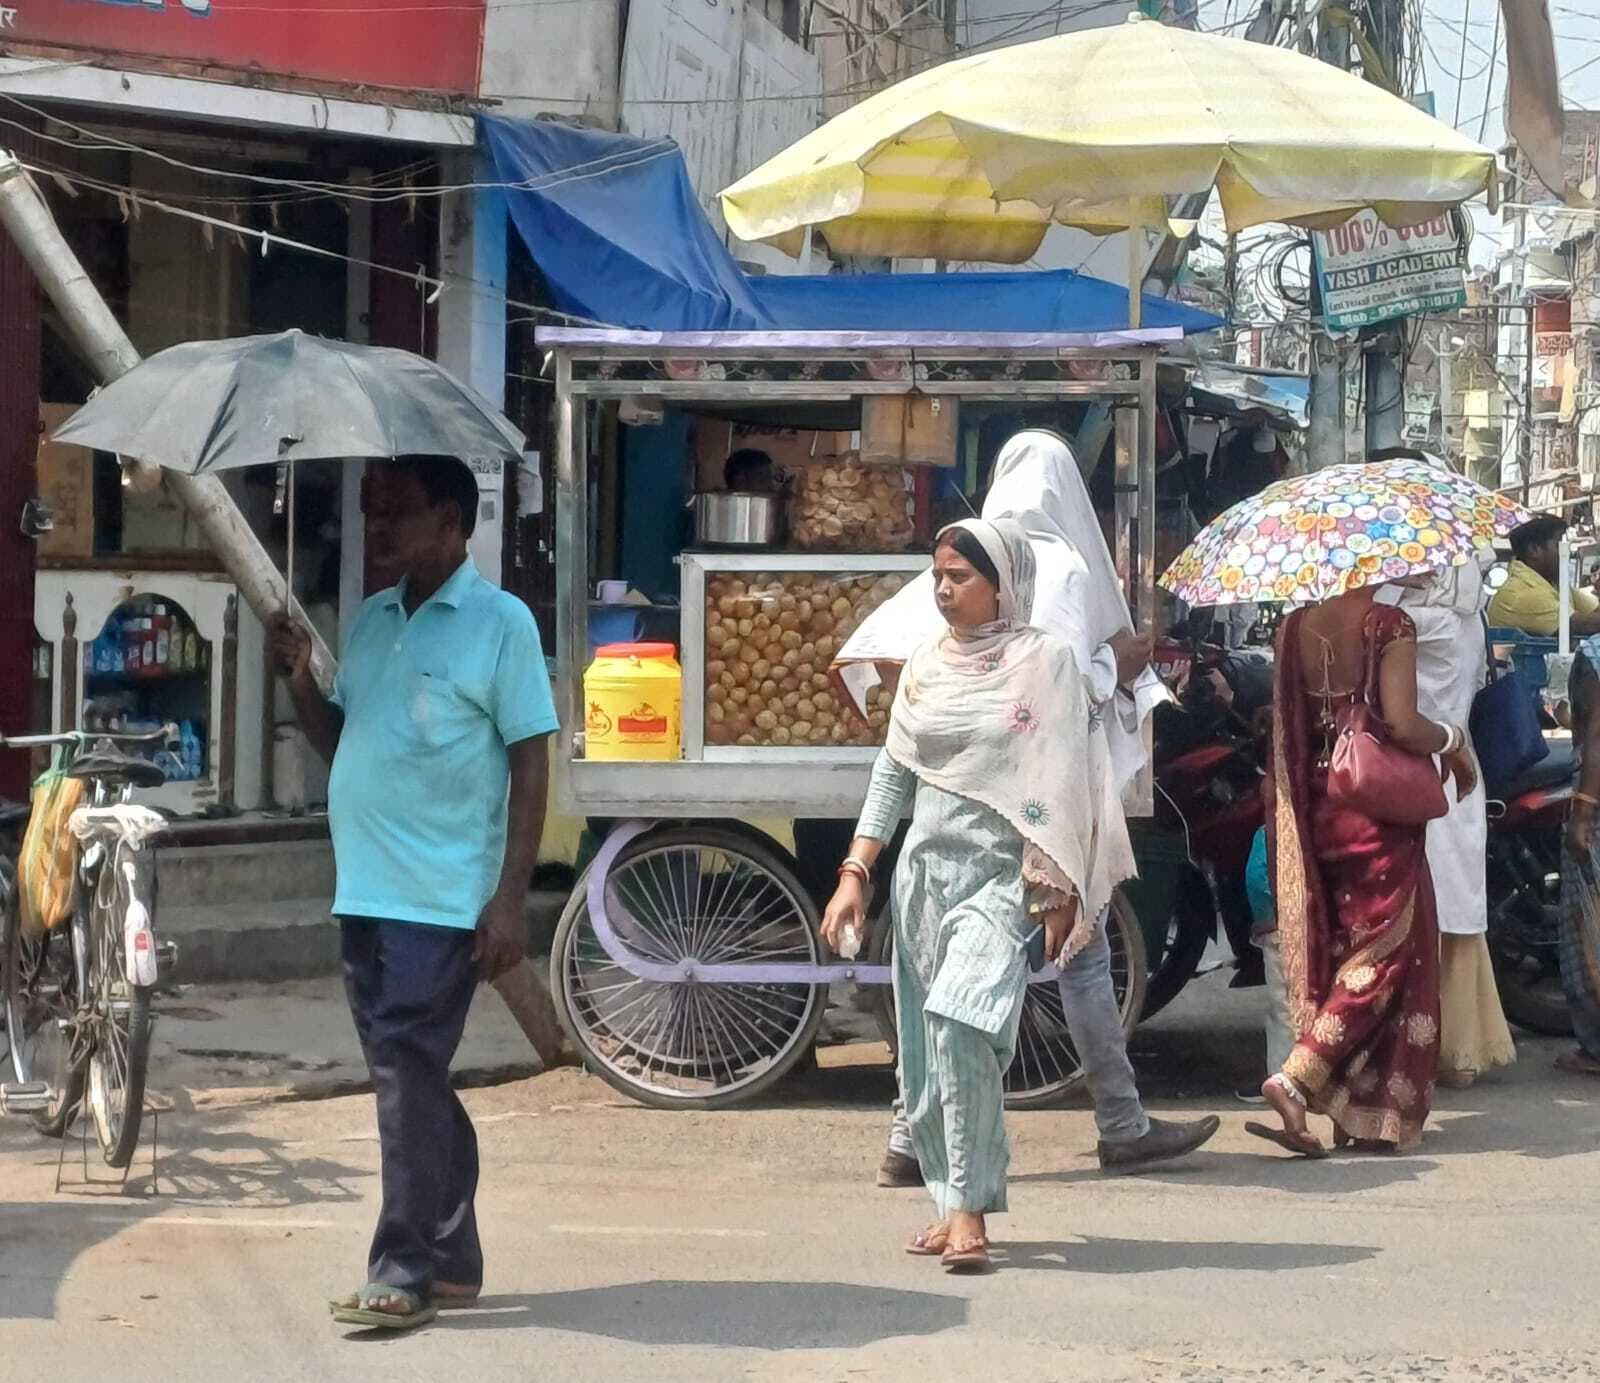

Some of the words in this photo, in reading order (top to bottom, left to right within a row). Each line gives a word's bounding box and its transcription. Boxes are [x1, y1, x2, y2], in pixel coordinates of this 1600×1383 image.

[1326, 218, 1389, 257] 100%
[1326, 268, 1370, 290] YASH
[1375, 251, 1457, 280] ACADEMY
